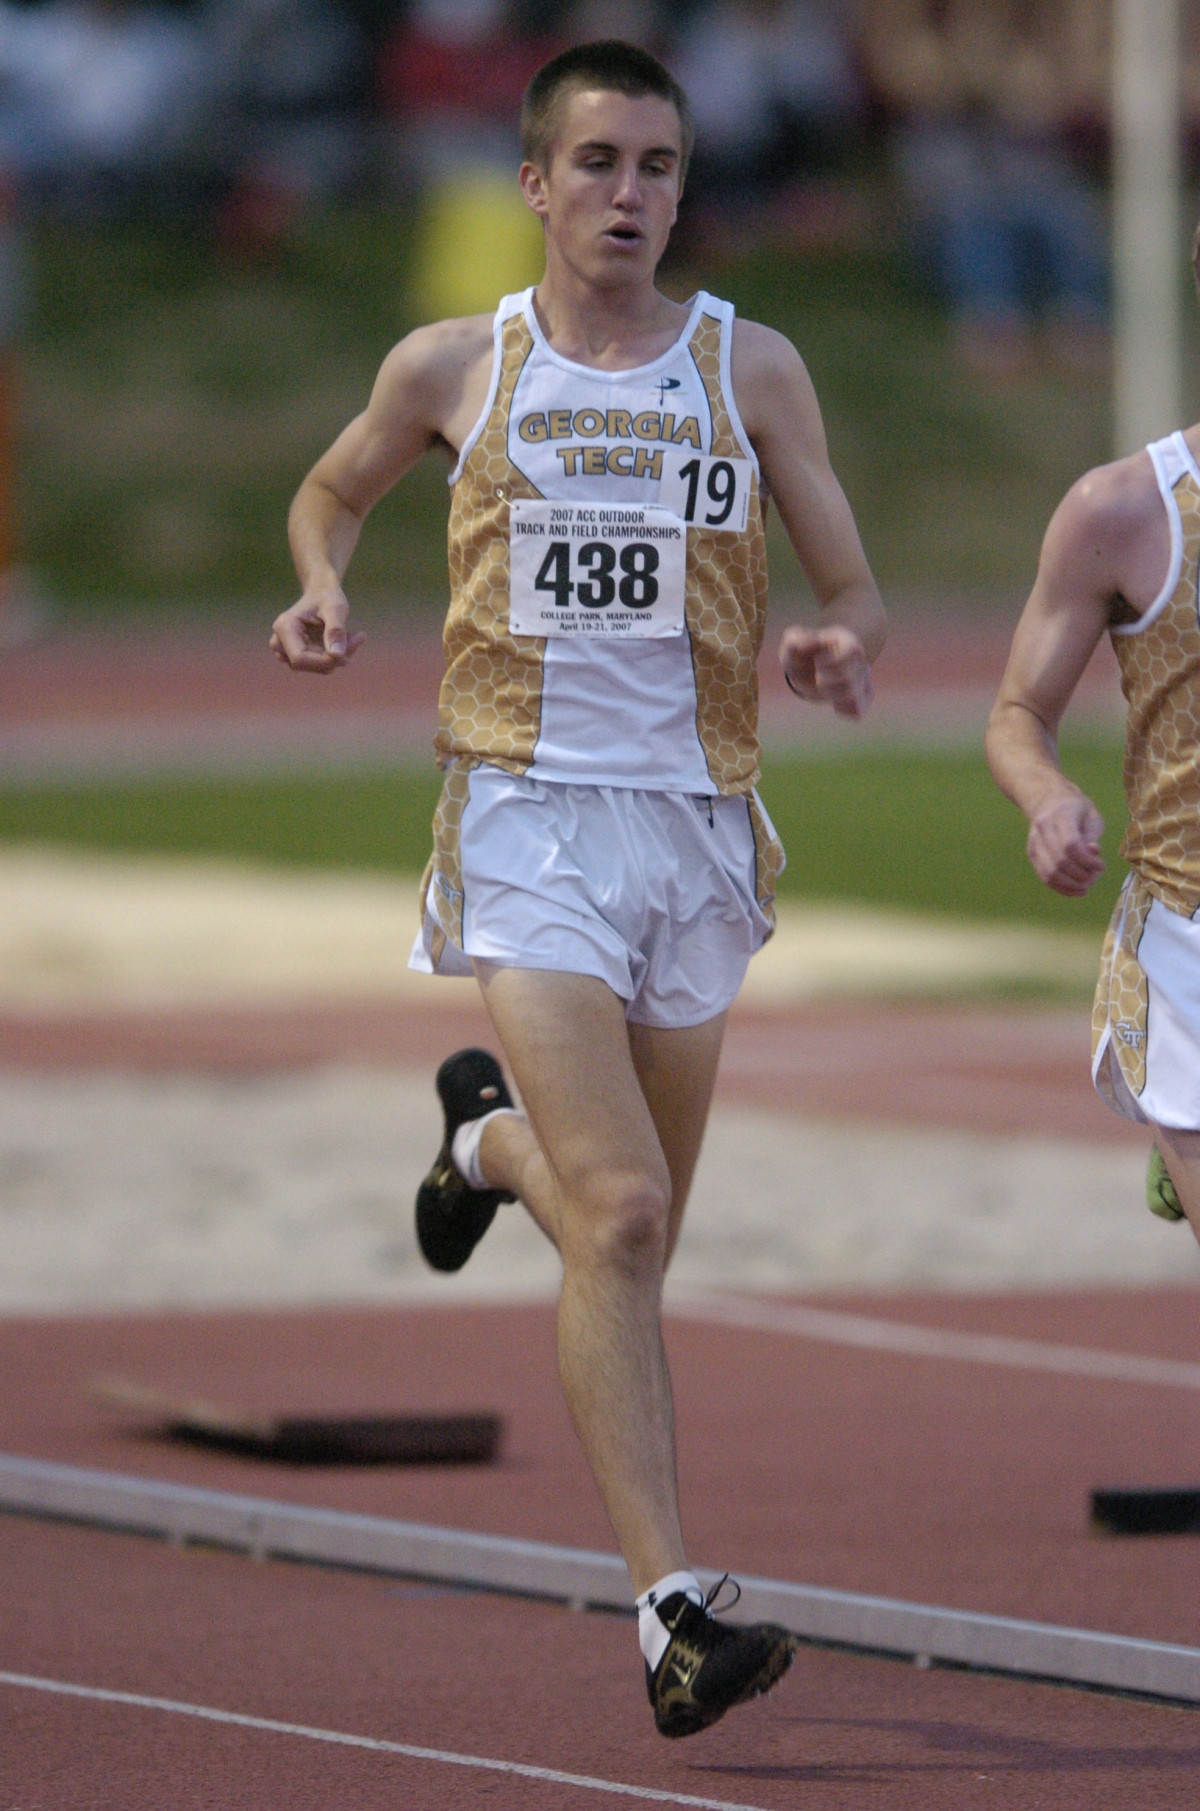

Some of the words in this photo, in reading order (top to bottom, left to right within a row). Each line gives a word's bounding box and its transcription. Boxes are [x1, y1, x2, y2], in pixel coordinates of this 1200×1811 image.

[518, 408, 703, 450] GEORGIA
[556, 446, 665, 480] TECH
[678, 459, 736, 526] 19
[550, 509, 574, 522] 2007
[576, 510, 596, 522] ACC
[599, 510, 645, 524] OUTDOOR
[516, 523, 546, 535] TRACK
[549, 524, 568, 537] AND
[571, 525, 598, 538] FIELD
[601, 526, 681, 540] CHAMPIONSHIPS
[534, 541, 660, 609] 438
[540, 612, 576, 621] COLLEGE
[579, 612, 603, 622] PARK,
[606, 612, 652, 621] MARYLAND
[559, 622, 578, 632] April
[582, 622, 608, 632] 19-21,
[610, 622, 632, 631] 2007
